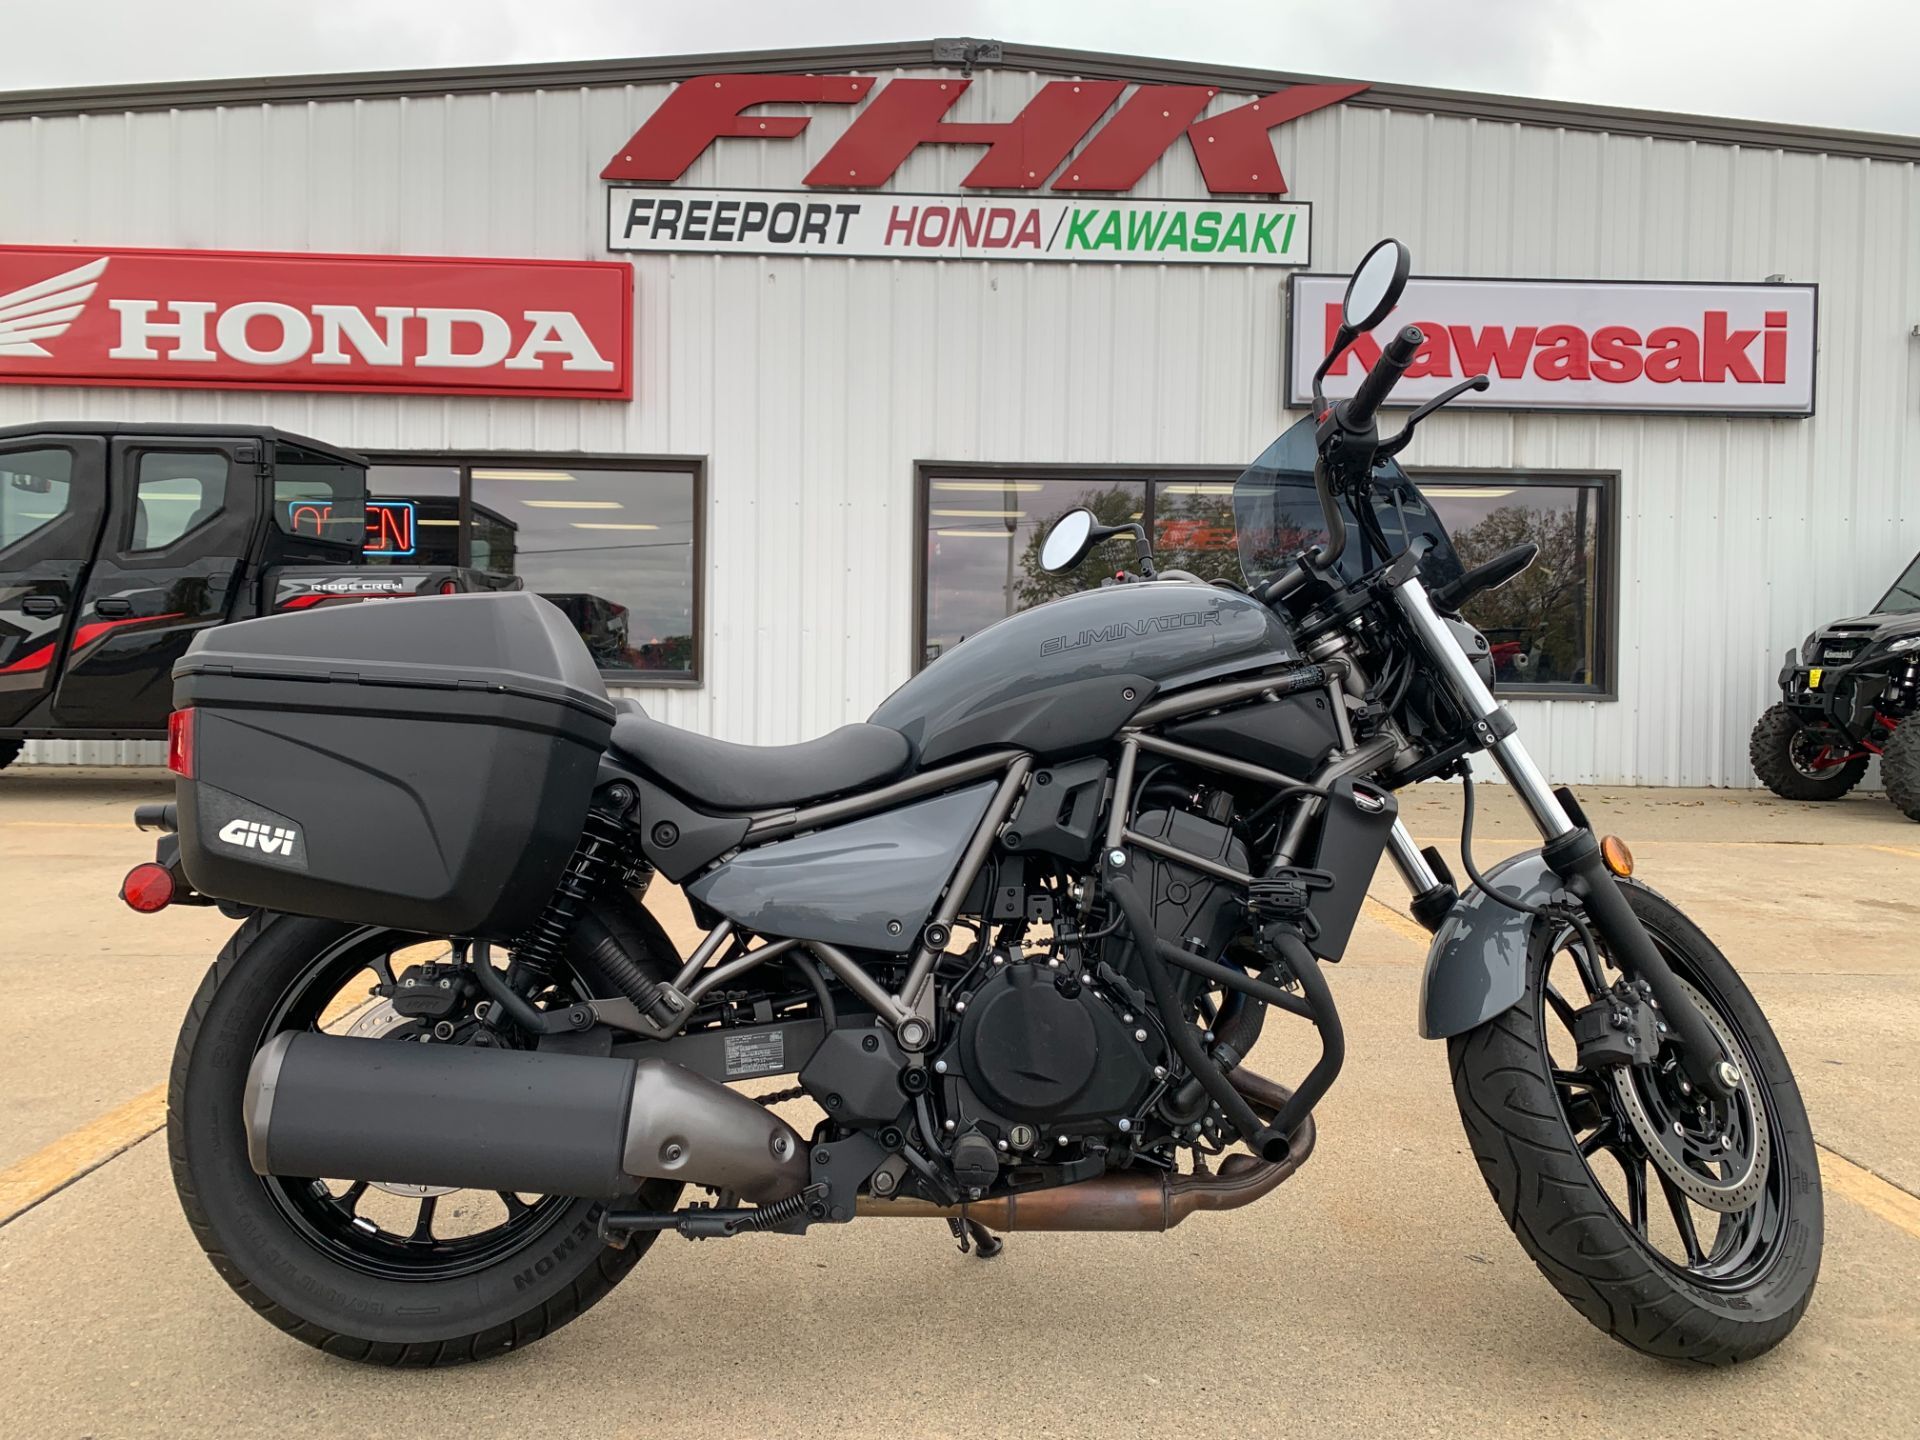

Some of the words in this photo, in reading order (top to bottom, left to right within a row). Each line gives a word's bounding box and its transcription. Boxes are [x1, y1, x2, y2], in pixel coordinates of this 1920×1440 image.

[600, 73, 1369, 195] FHK
[624, 198, 861, 246] FREEPORT
[109, 300, 614, 372] HONDA
[1325, 302, 1787, 384] Kawasaki
[294, 507, 409, 550] OEN
[311, 583, 357, 591] RIDGE
[1040, 610, 1221, 657] ELIMINATOR
[218, 819, 296, 856] GIVI
